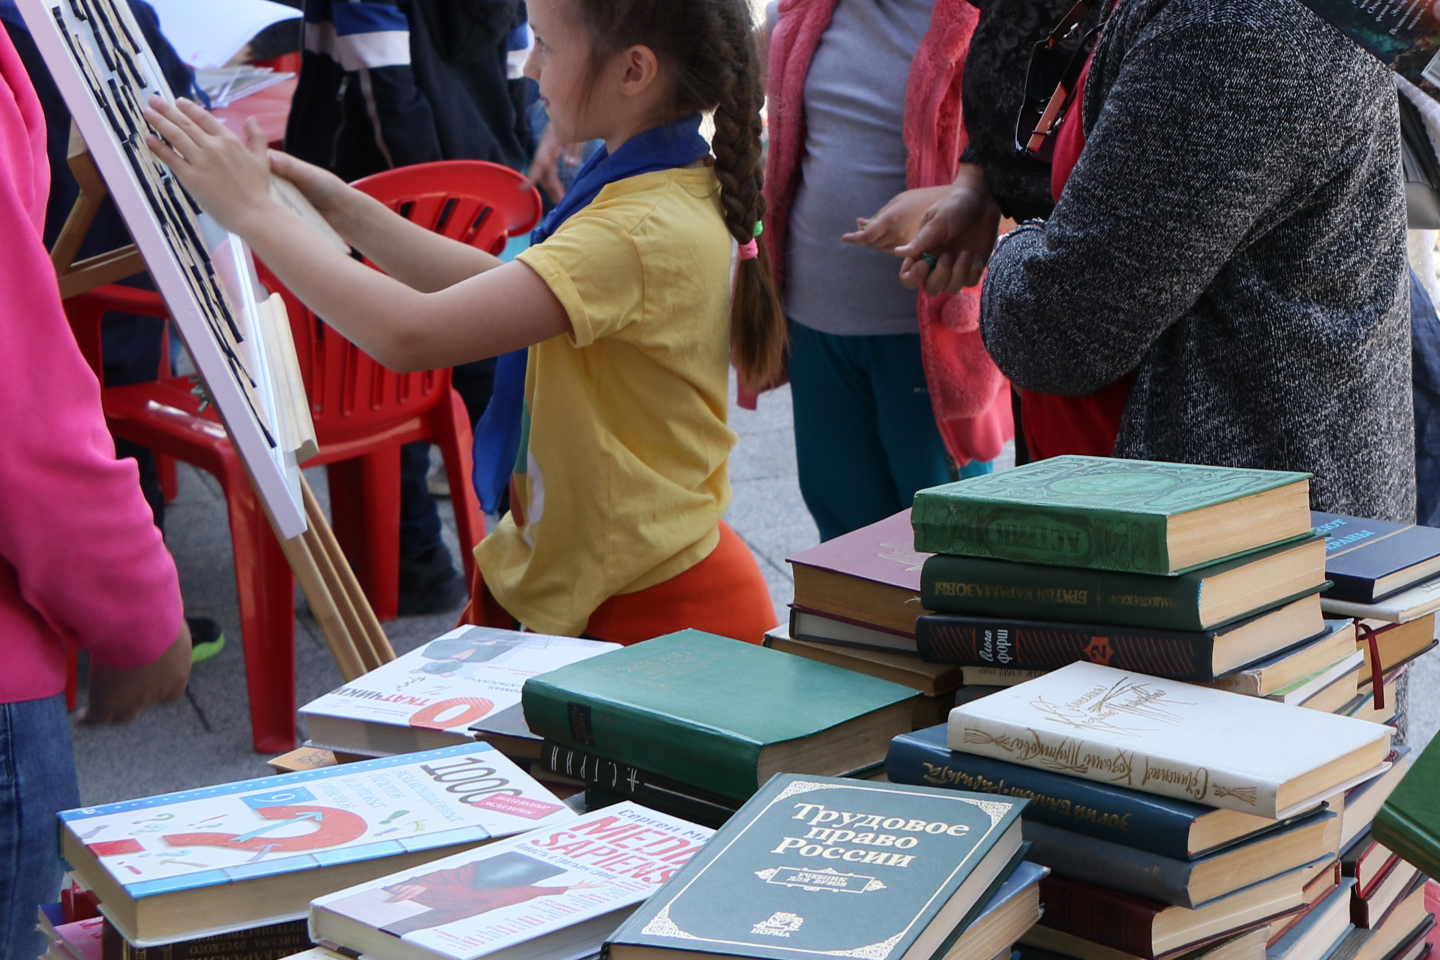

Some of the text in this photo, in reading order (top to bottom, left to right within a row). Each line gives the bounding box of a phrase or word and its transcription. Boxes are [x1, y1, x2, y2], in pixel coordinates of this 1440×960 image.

[934, 580, 1088, 605] БРАТЬЯ КАРАМАЗОВЫ
[1092, 644, 1107, 659] 2
[1141, 755, 1209, 801] Сочинения
[618, 809, 683, 833] Сергей
[791, 802, 970, 837] Трудовое
[568, 815, 704, 866] MEDI
[803, 825, 919, 850] право
[770, 836, 916, 868] России
[786, 875, 848, 888] ДЛЯ ВУЗОВ
[797, 870, 848, 882] УЧЕБНИК
[750, 926, 791, 938] НОРМА
[189, 941, 246, 954] РУССКОГО
